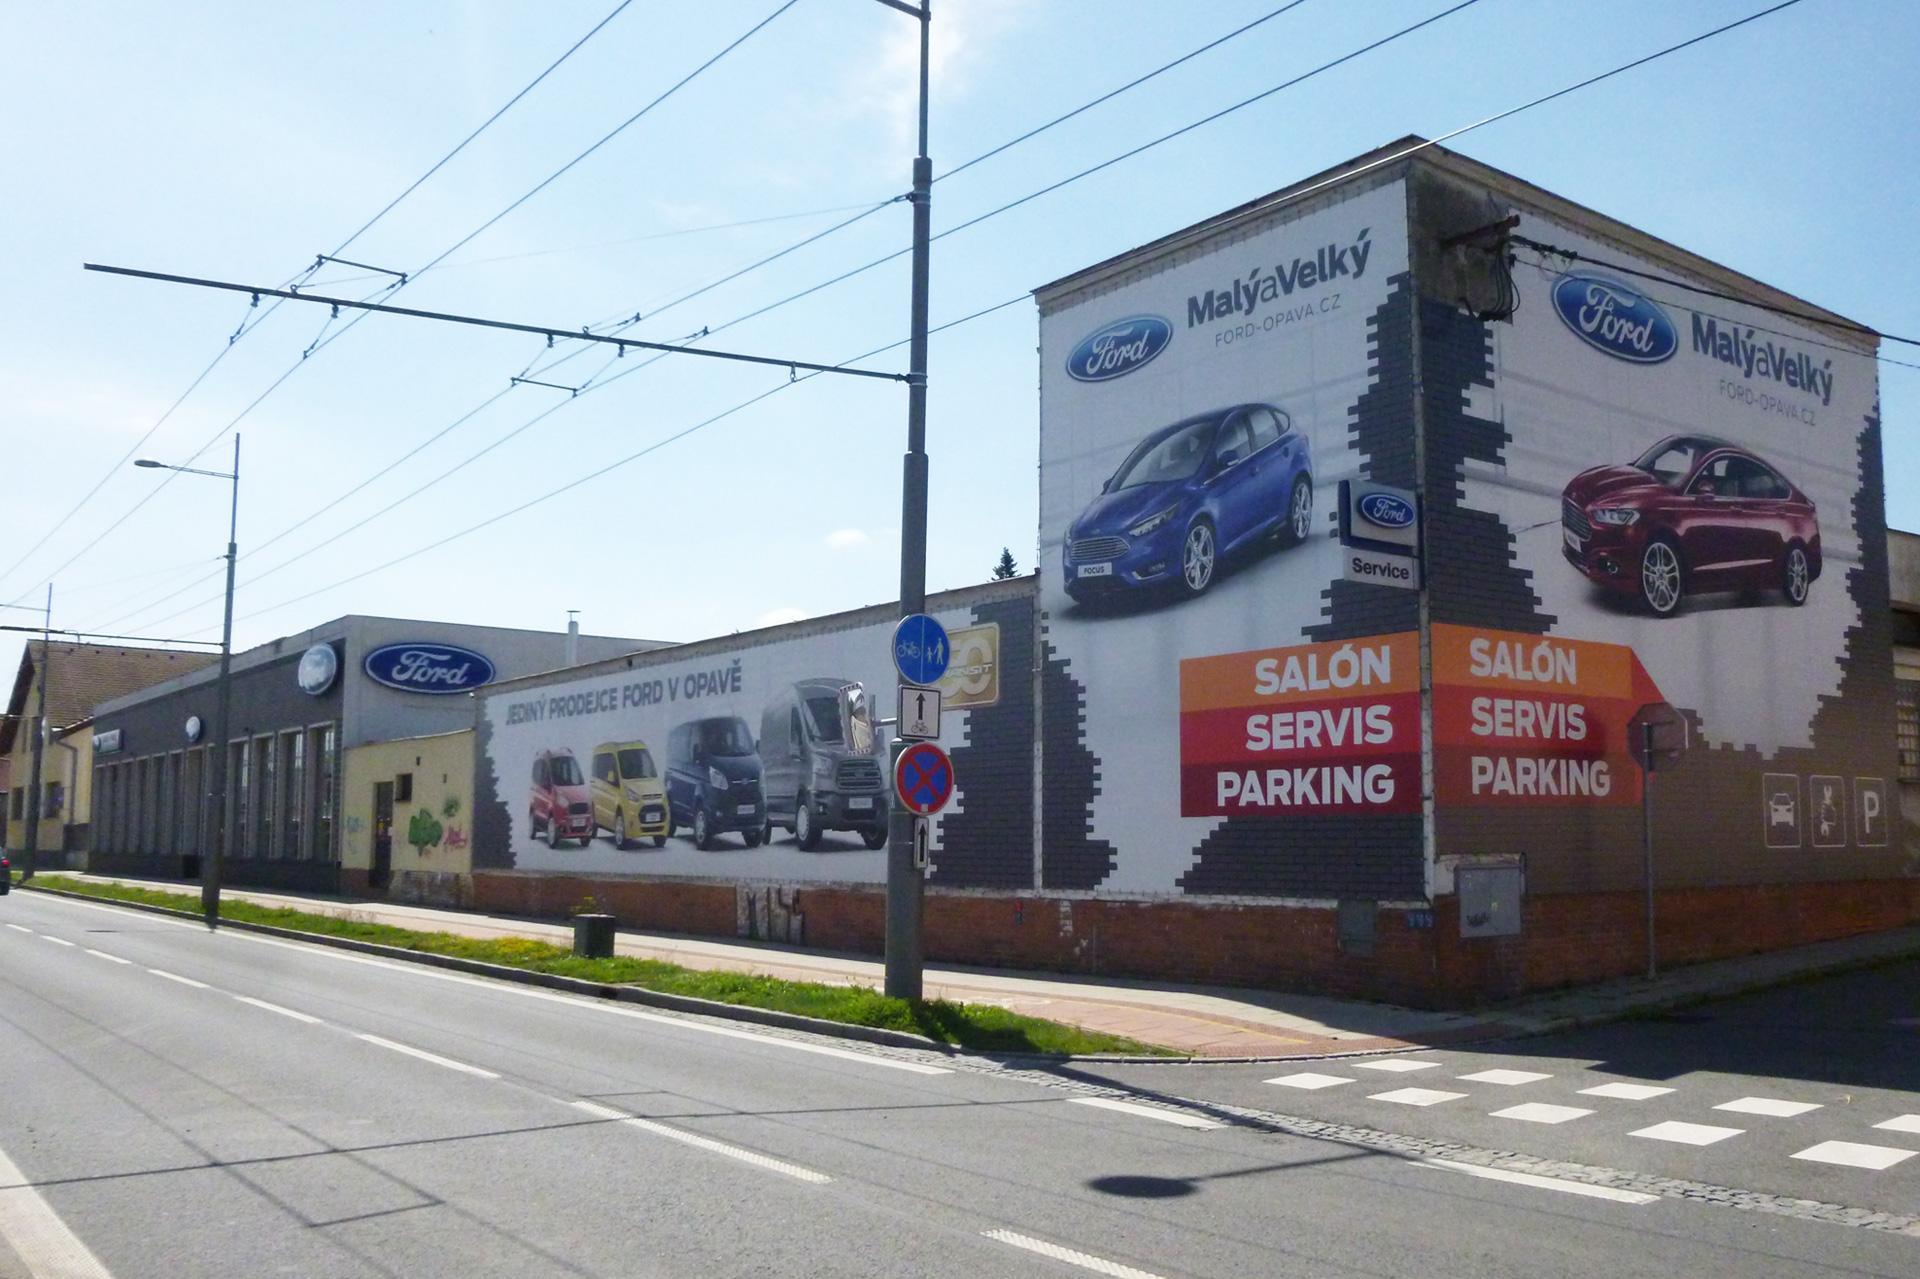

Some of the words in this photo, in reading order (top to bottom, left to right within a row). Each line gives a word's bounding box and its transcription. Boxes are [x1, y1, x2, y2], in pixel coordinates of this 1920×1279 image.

[1083, 566, 1105, 575] FOCUS
[1352, 557, 1410, 580] Service
[1254, 643, 1392, 696] SALÓN
[1470, 637, 1577, 685] SALÓN
[506, 692, 546, 726] JEDINÝ
[549, 686, 618, 720] PRODEJCE
[622, 679, 664, 709] FORD
[667, 676, 680, 701] V
[684, 657, 743, 700] OPAVĚ
[1246, 704, 1393, 751] SERVIS
[1471, 696, 1587, 741] SERVIS
[1217, 763, 1395, 808] PARKING
[1471, 756, 1611, 797] PARKING
[1863, 790, 1880, 834] P
